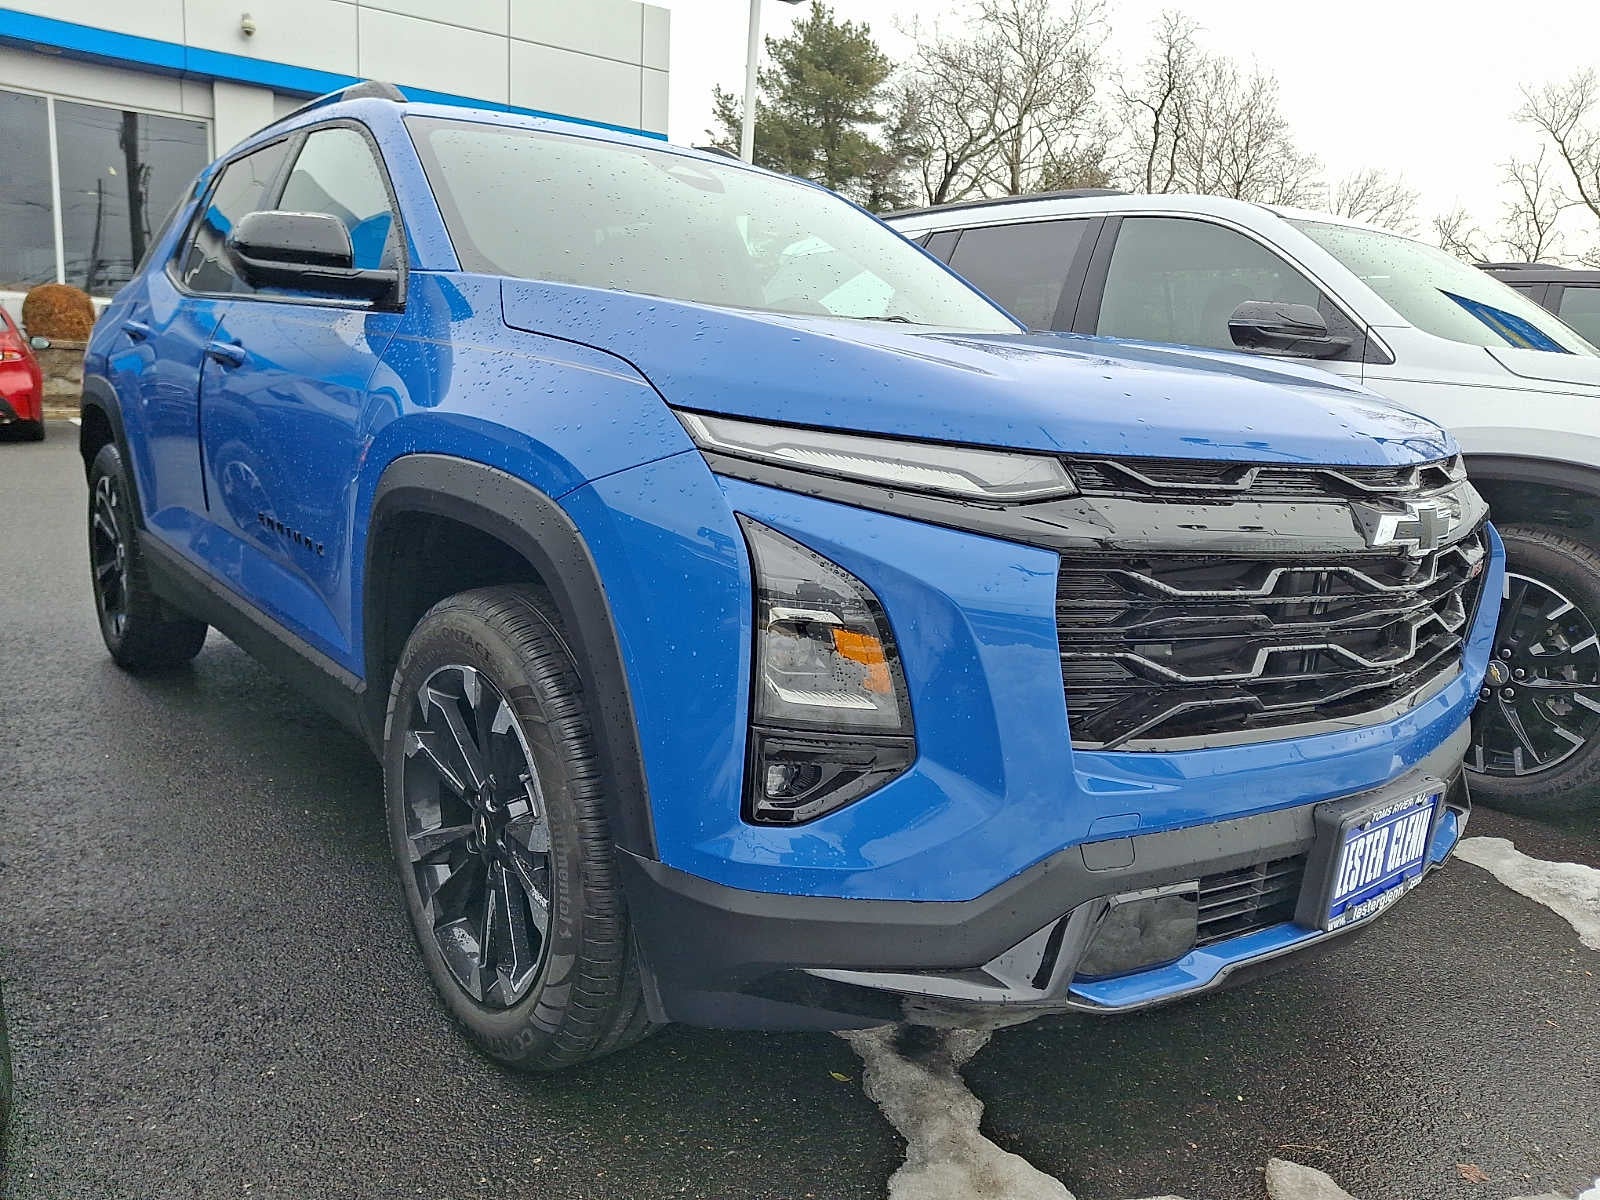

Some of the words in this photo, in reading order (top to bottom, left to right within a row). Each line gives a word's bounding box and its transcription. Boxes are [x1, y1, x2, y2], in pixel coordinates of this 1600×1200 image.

[1371, 806, 1392, 822] TOMS
[1392, 798, 1414, 814] RIVER
[1334, 826, 1390, 899] LESTER
[1386, 807, 1433, 873] GLENN
